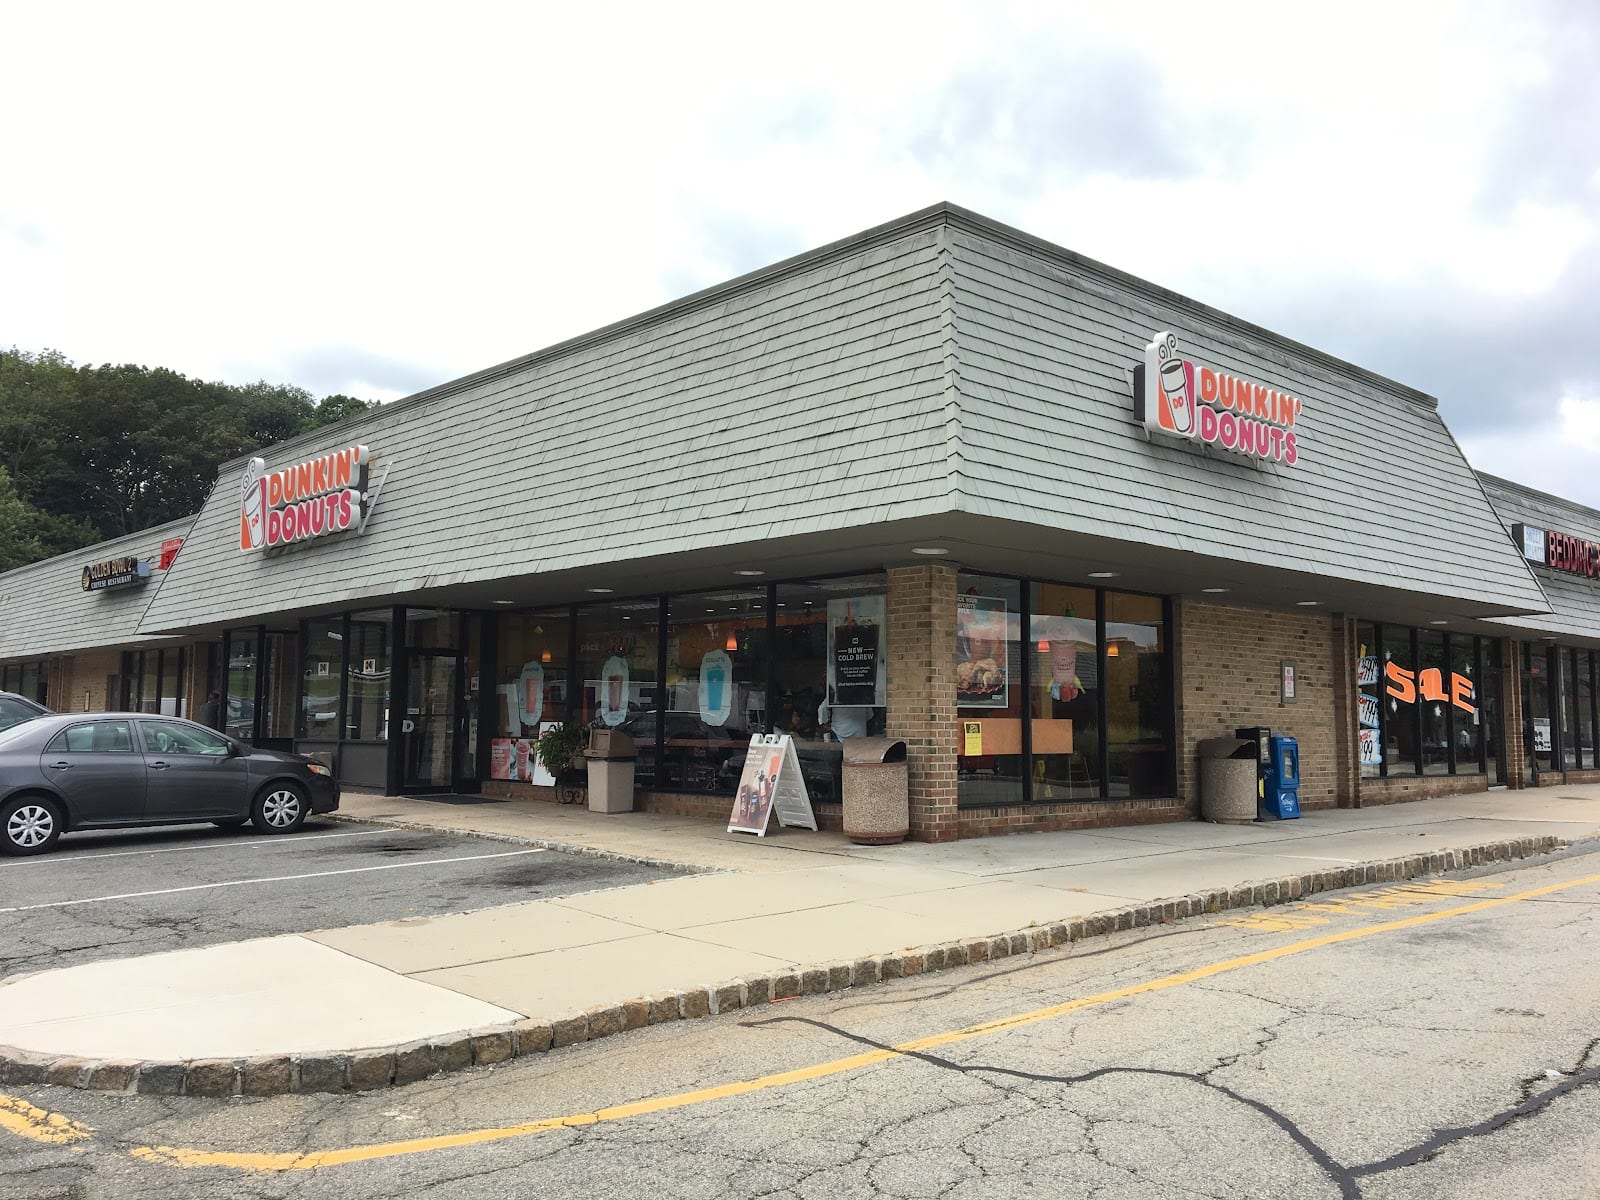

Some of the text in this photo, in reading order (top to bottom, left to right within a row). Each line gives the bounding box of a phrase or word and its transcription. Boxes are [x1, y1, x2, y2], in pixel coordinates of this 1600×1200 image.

[1200, 367, 1302, 428] DUNKIN'
[1200, 405, 1298, 465] DONUTS
[269, 446, 360, 507] DUNKIN'
[268, 489, 352, 545] DONUTS
[91, 561, 111, 579] GOLDEN
[112, 558, 127, 574] BOWL
[1549, 531, 1594, 576] BEDDING
[91, 574, 132, 589] CHINESE RESTAURANT
[838, 653, 874, 662] COLD BREW
[1386, 660, 1475, 714] SALE
